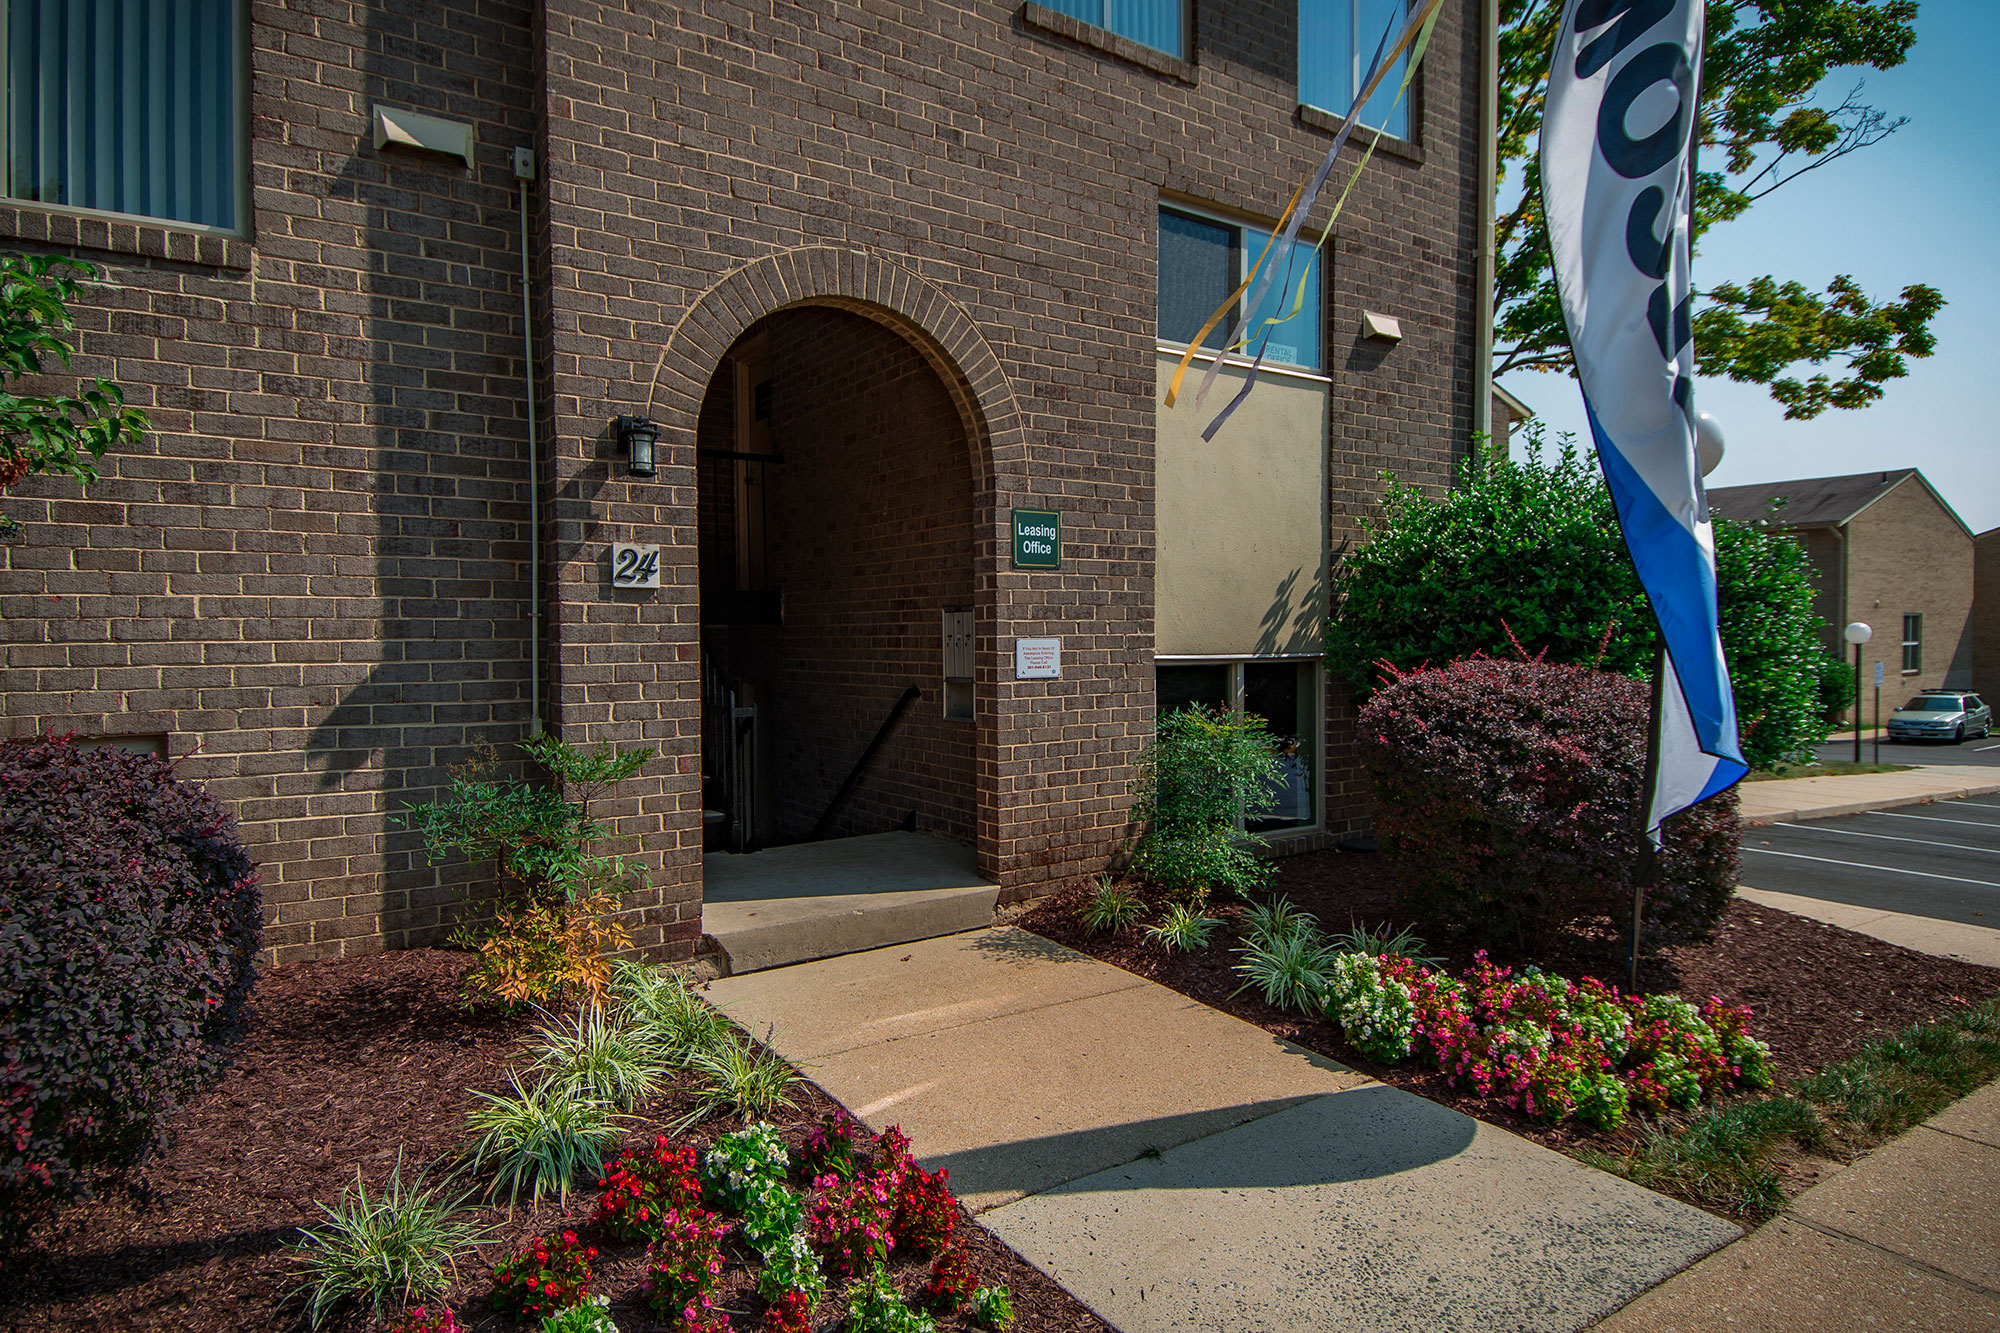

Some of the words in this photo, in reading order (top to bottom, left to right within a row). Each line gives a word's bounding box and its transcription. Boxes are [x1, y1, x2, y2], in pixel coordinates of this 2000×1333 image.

[1266, 345, 1292, 357] RENTAL
[1018, 522, 1056, 540] Leasing
[1023, 540, 1052, 554] Office
[614, 548, 659, 584] 24
